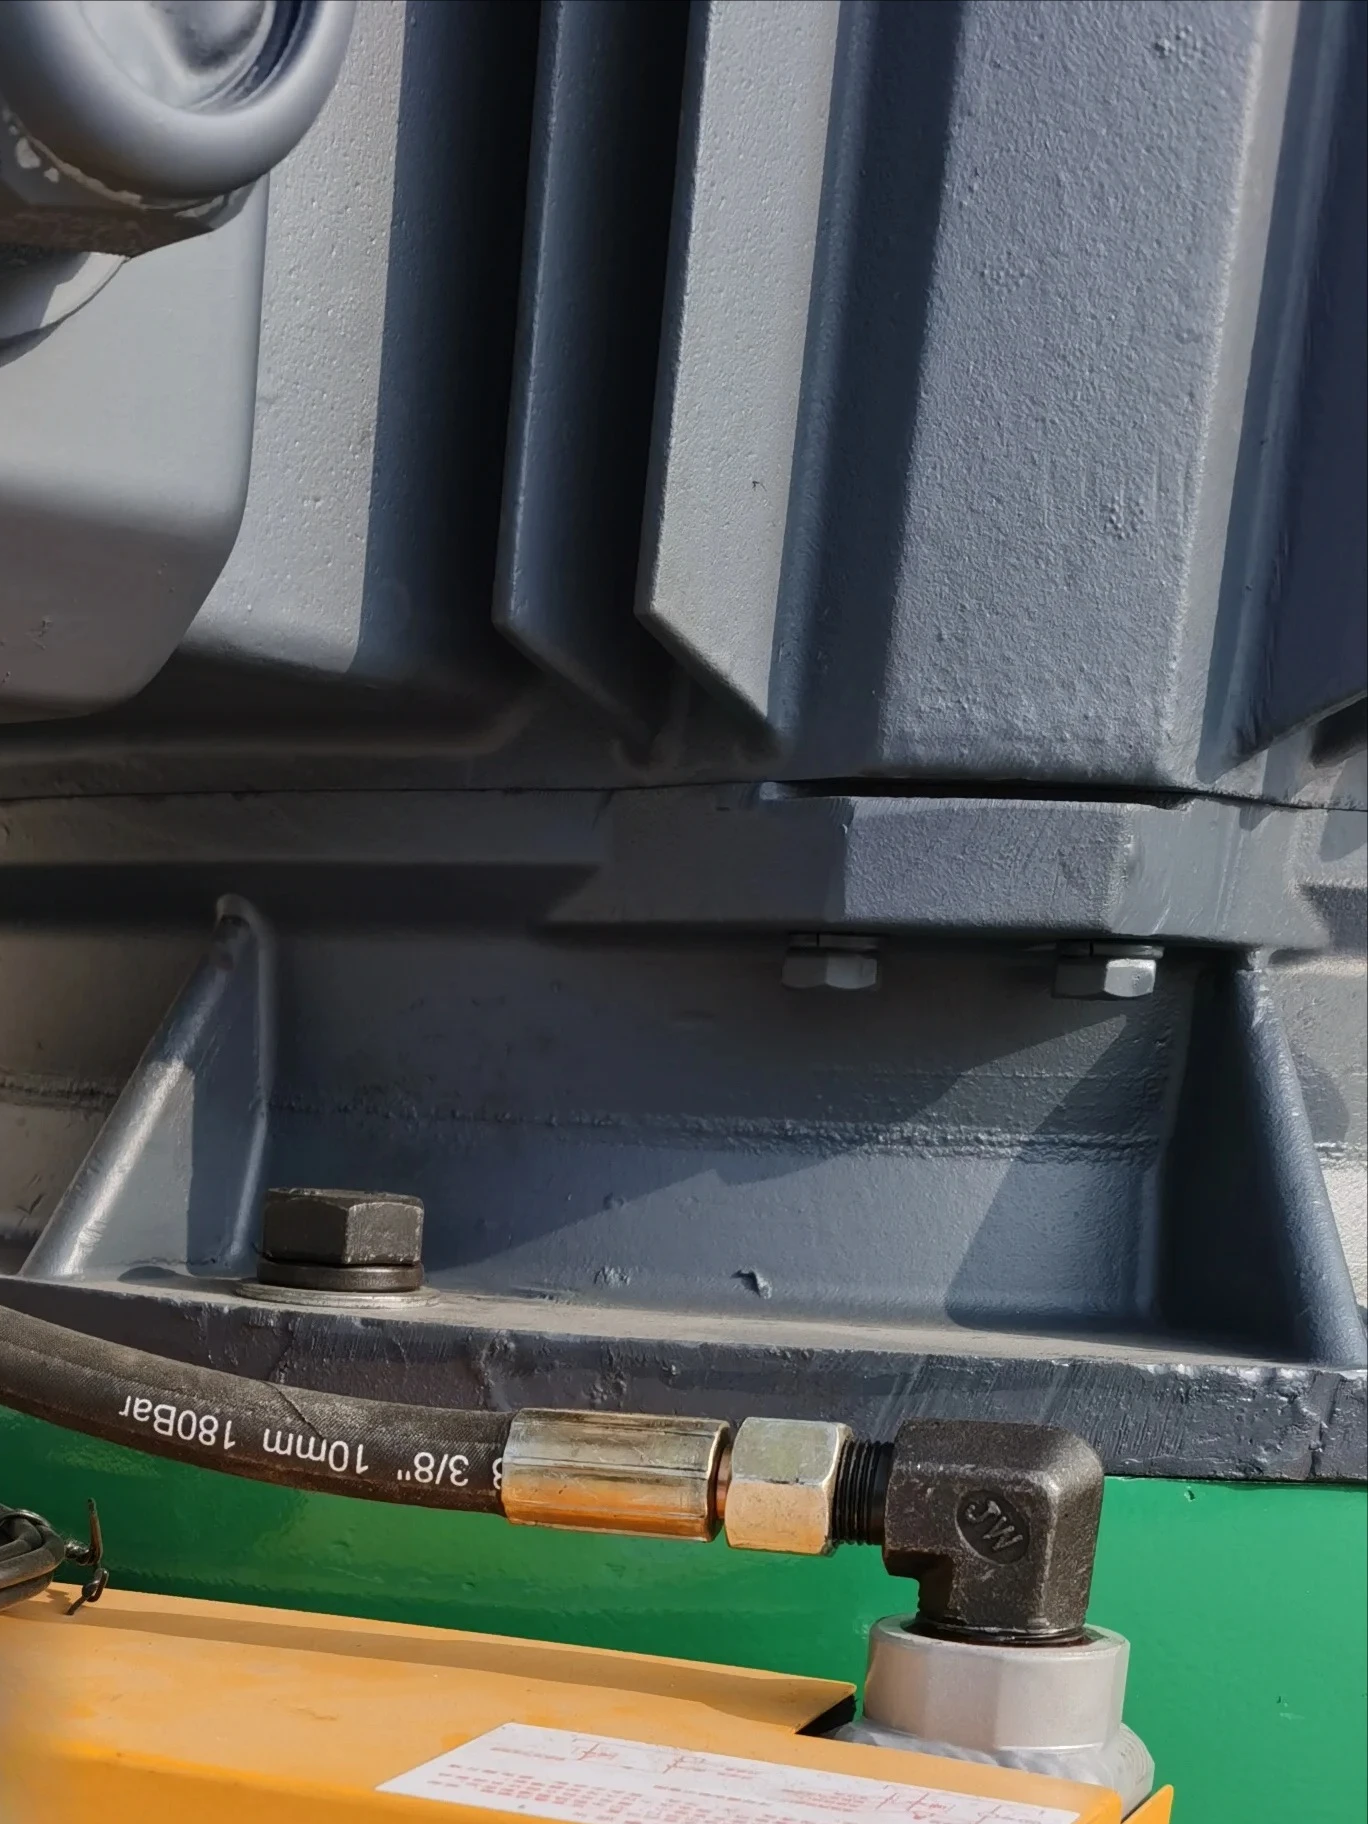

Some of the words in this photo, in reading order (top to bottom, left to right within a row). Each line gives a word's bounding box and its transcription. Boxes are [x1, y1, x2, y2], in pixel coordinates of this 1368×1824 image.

[119, 1395, 236, 1451] 180Bar
[262, 1428, 370, 1475] 10mm
[397, 1451, 470, 1488] 3/8"
